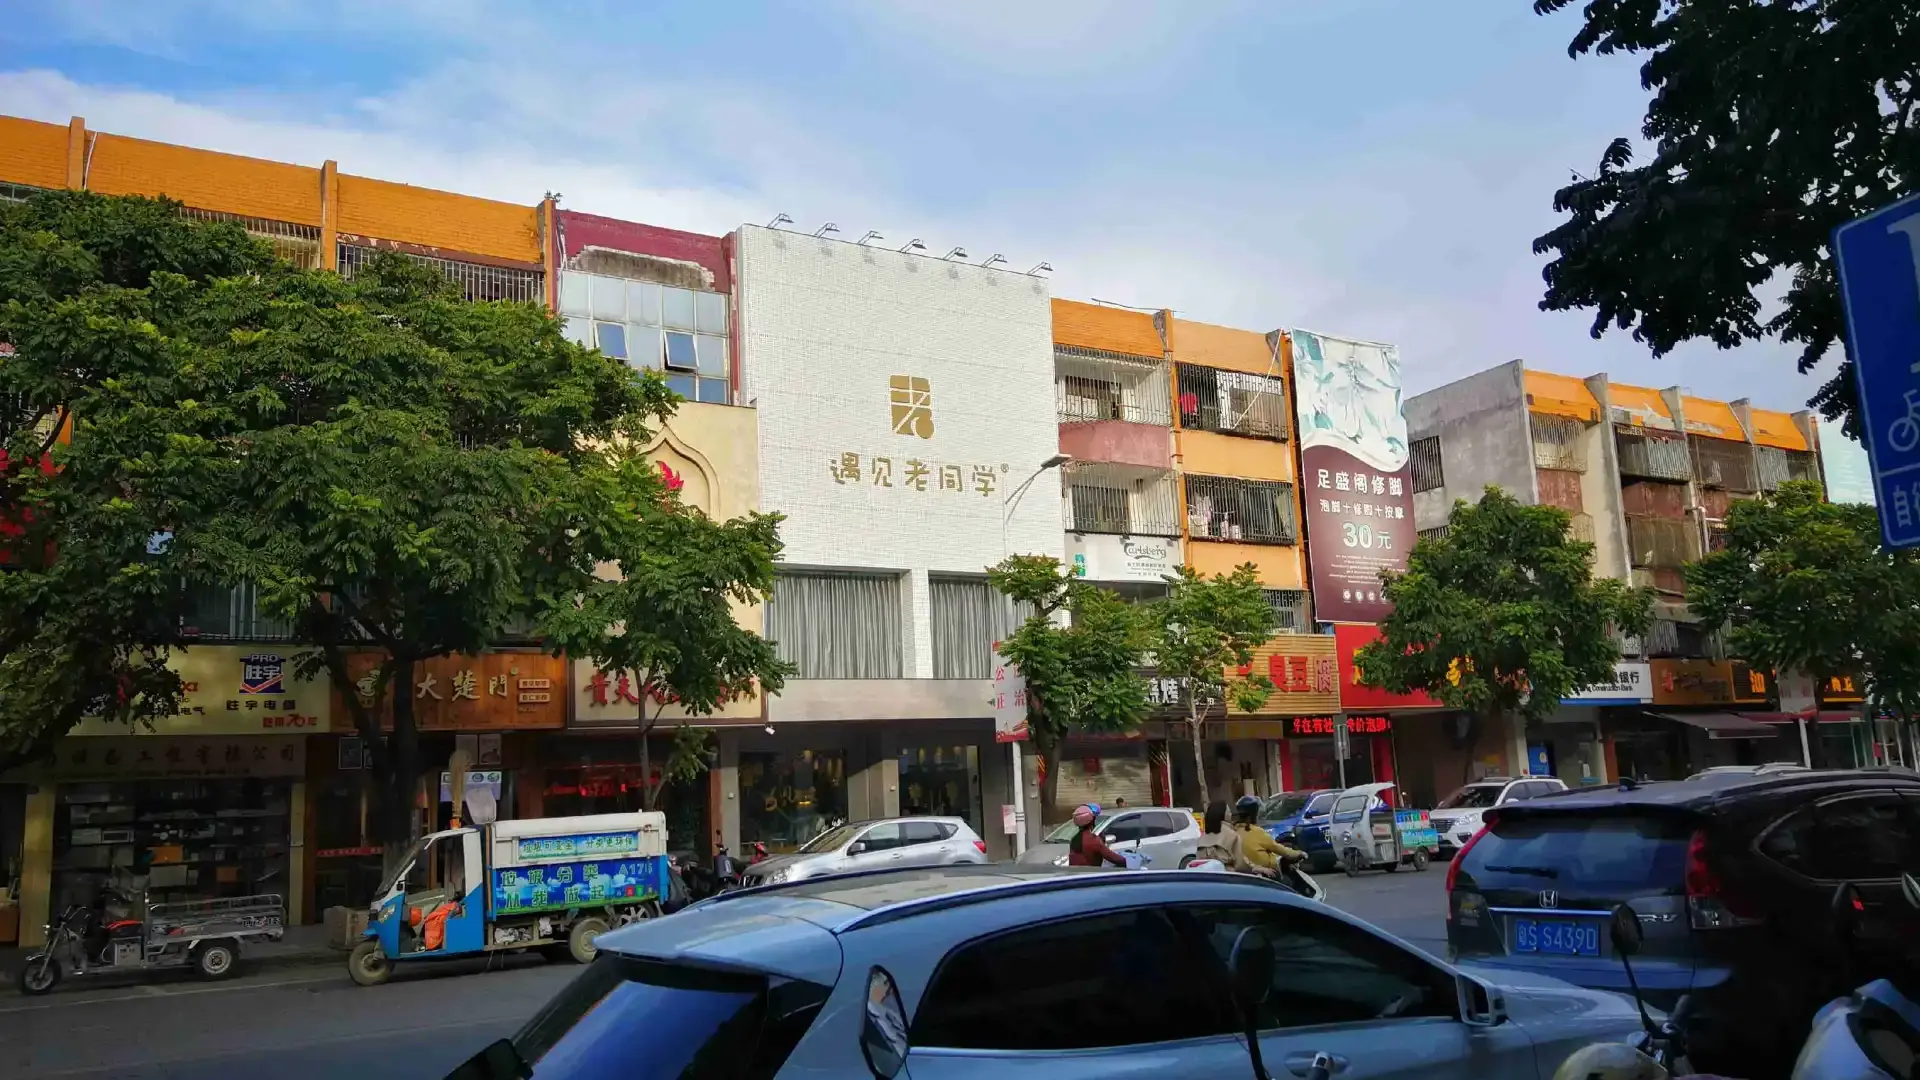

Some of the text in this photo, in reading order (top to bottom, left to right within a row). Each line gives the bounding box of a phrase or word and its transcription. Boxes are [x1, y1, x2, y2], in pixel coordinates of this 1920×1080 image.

[830, 451, 997, 497] 遇见老同学
[1317, 468, 1403, 496] 足盛阁修脚
[1124, 542, 1167, 560] Carlsberg
[251, 654, 278, 662] PRO
[245, 664, 280, 679] 胜宇
[501, 863, 600, 888] 垃圾分类
[505, 885, 606, 909] 从我做起
